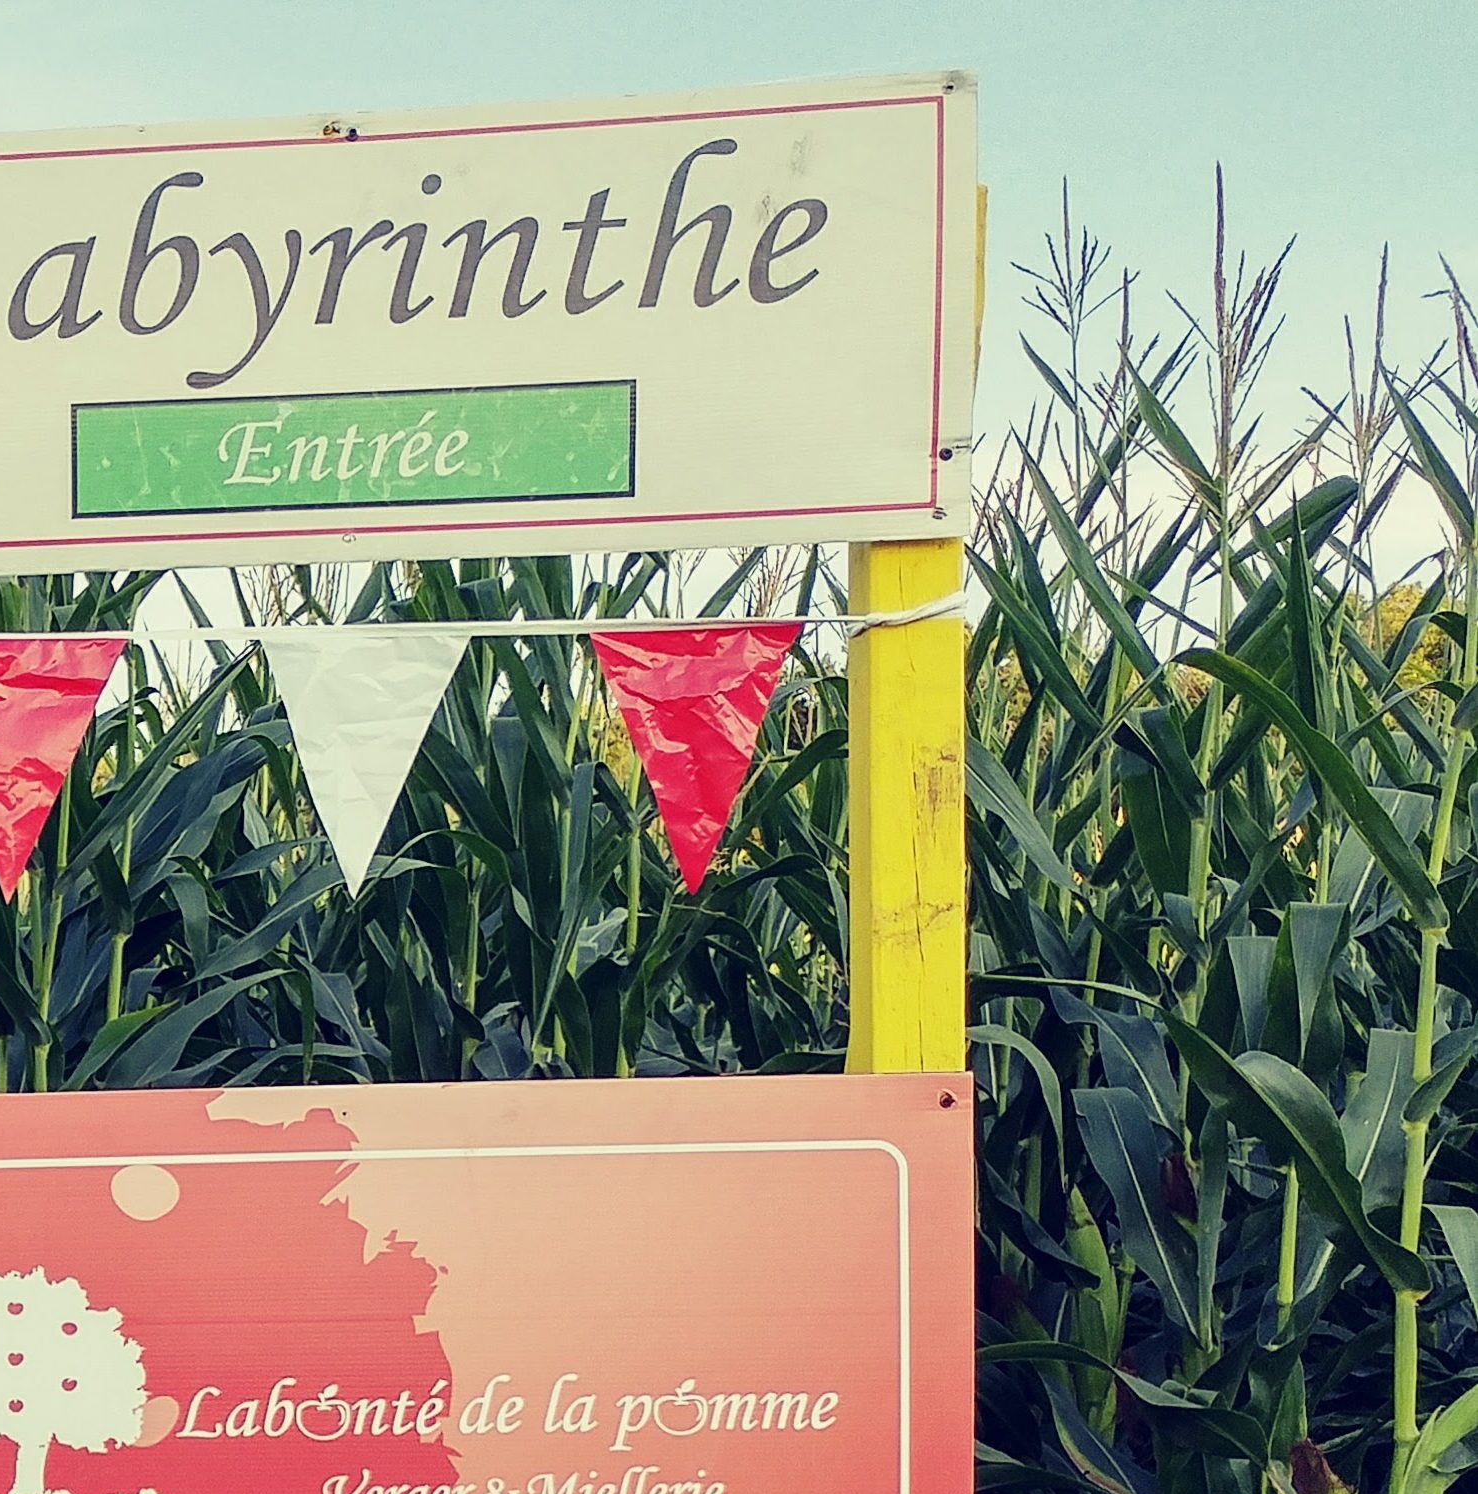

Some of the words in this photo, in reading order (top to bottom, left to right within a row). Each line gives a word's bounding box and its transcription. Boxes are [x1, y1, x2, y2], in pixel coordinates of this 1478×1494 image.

[217, 409, 470, 486] Entrée
[175, 1376, 449, 1441] Labonté
[459, 1373, 525, 1435] de
[542, 1373, 599, 1435] la
[609, 1378, 841, 1453] pomme
